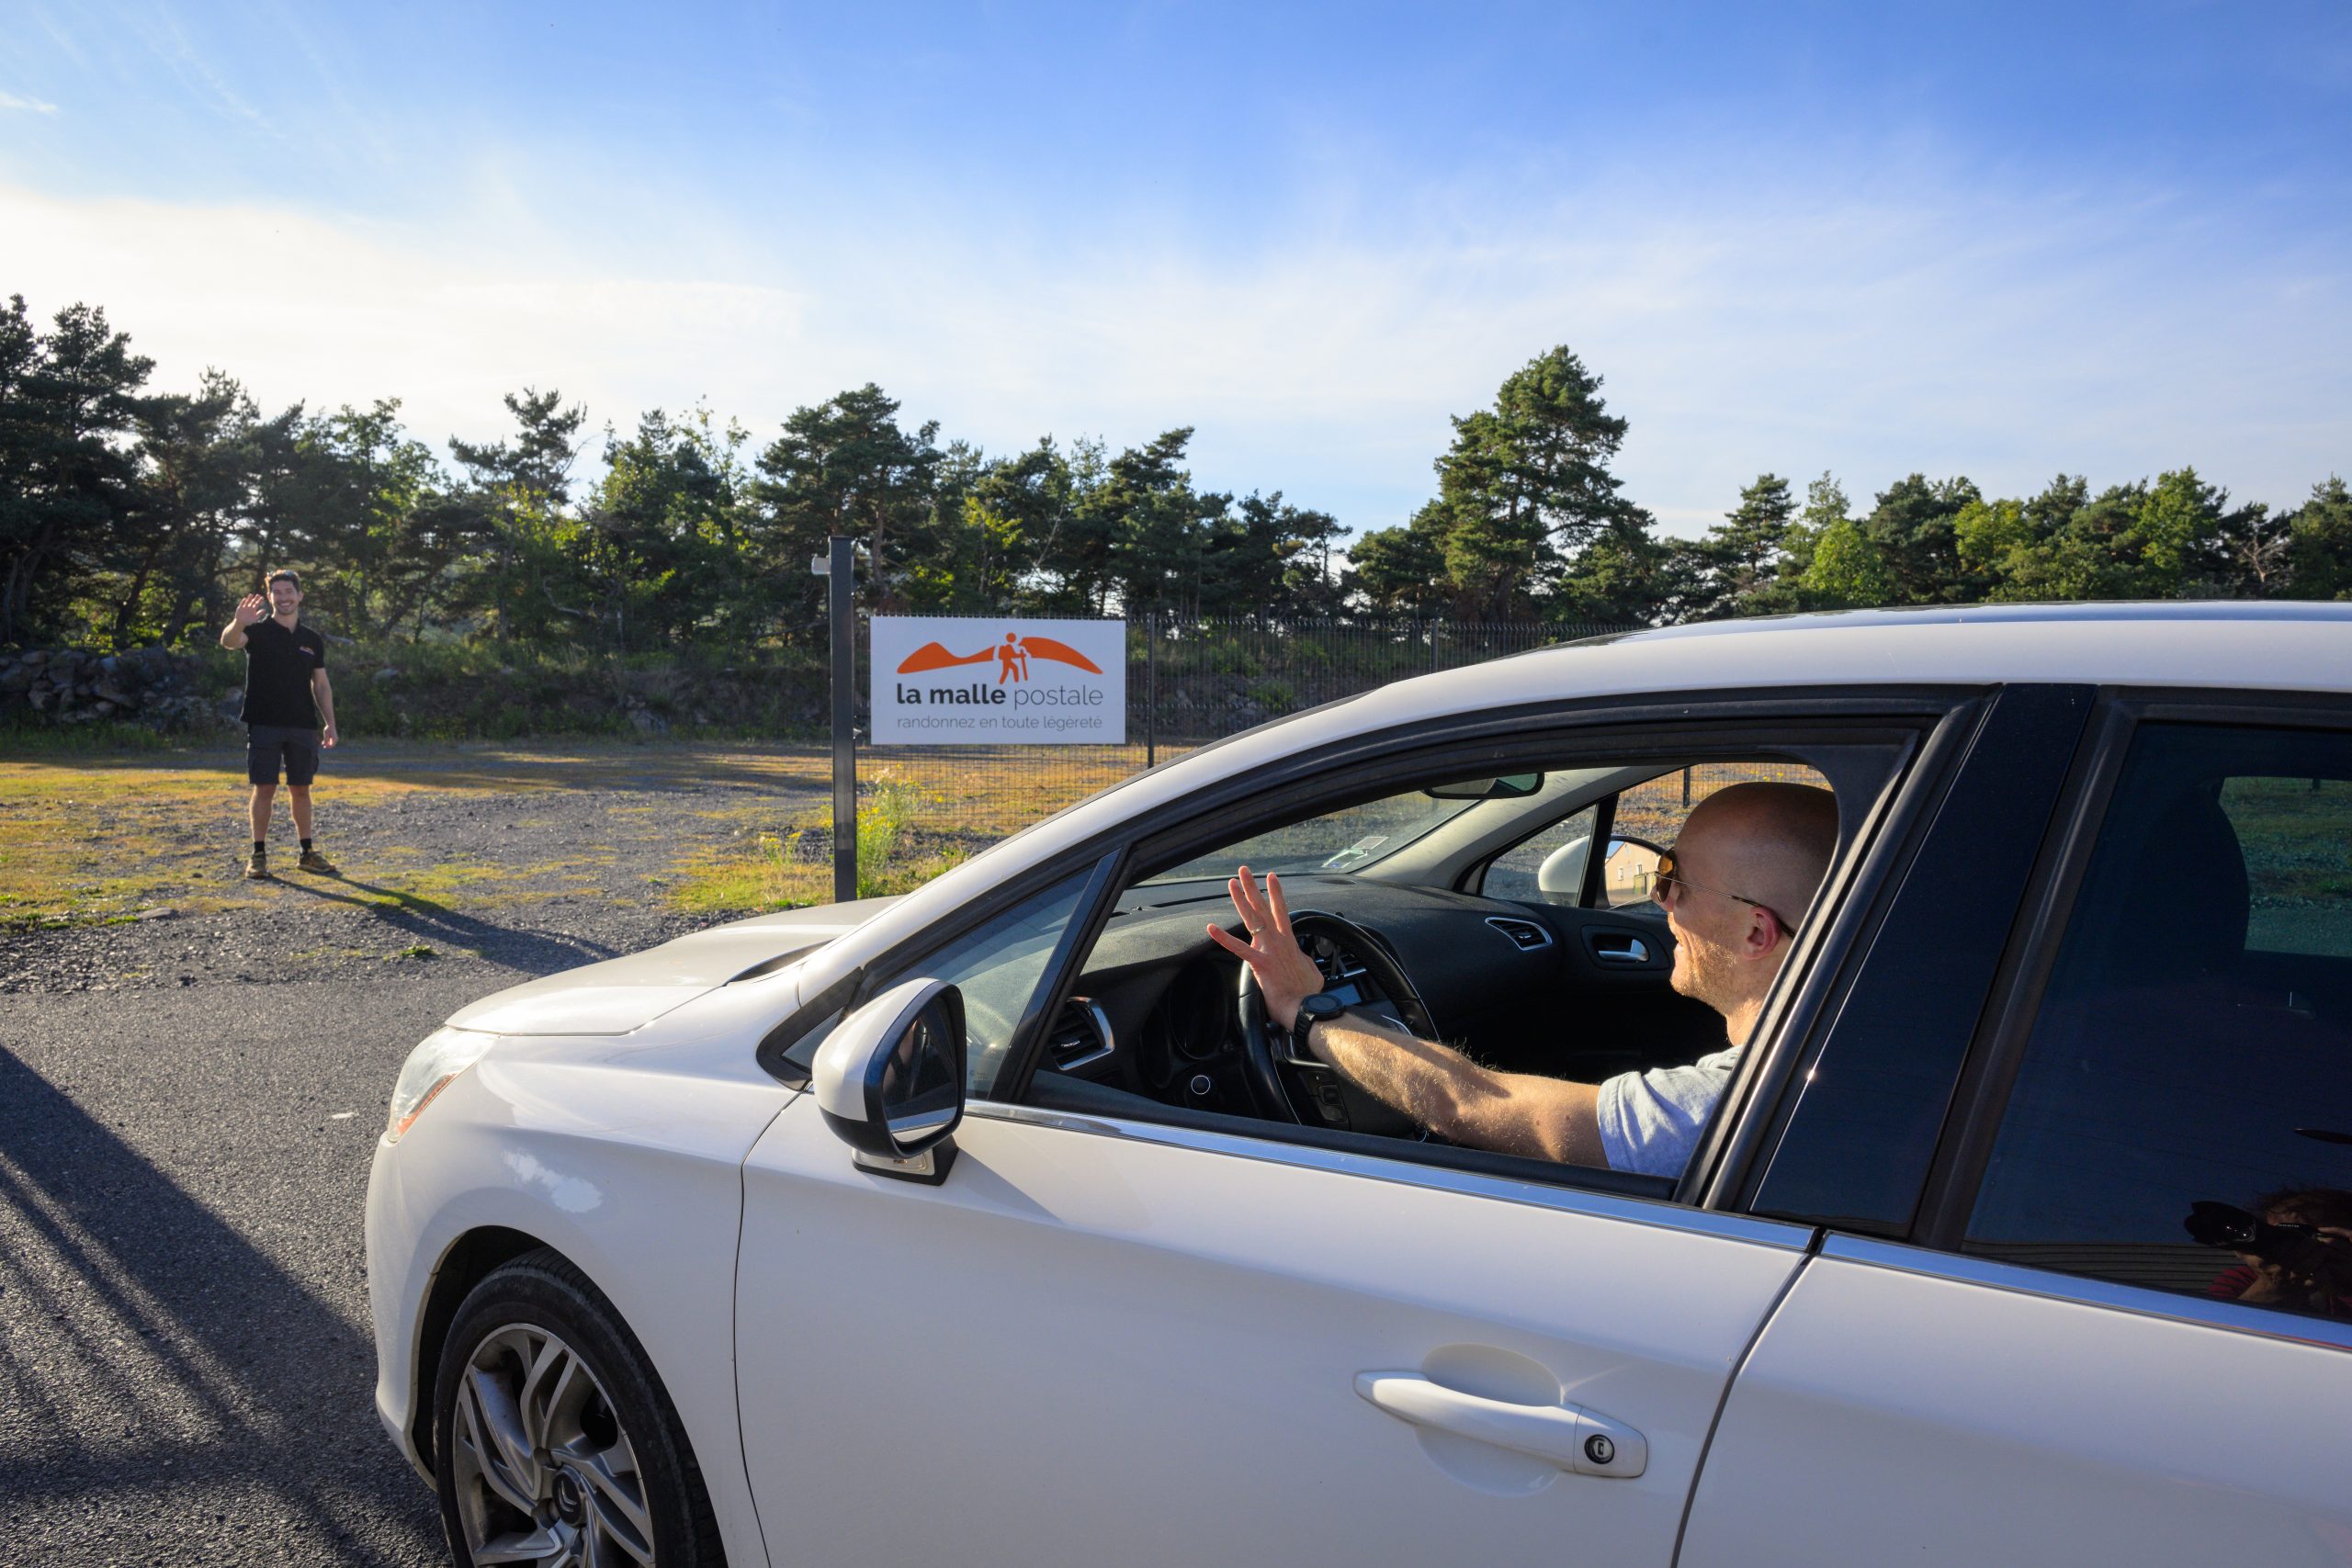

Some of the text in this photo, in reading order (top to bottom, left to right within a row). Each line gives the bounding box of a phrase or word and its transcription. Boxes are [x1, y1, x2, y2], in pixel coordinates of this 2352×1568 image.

[897, 682, 1102, 712] la malle postale
[897, 716, 1102, 732] randonnez en toute légèreté
